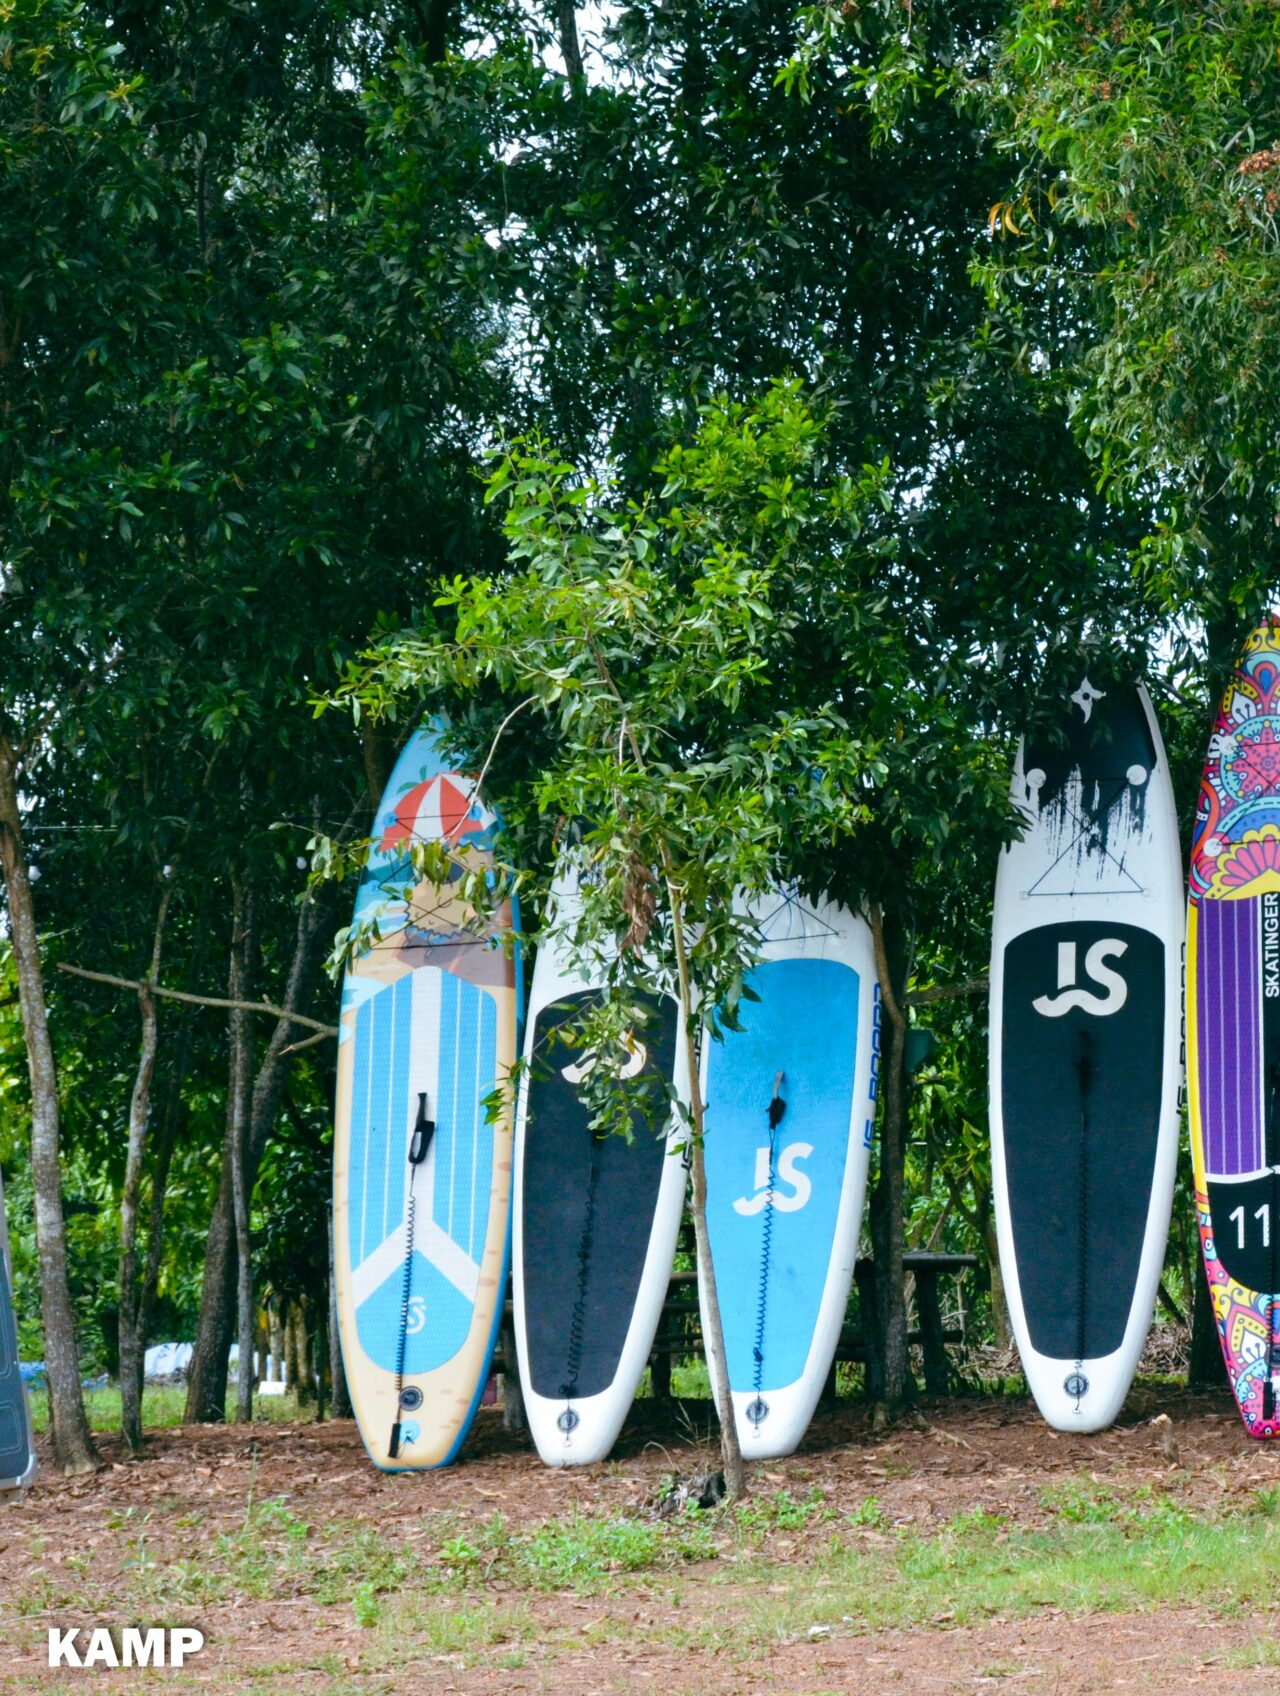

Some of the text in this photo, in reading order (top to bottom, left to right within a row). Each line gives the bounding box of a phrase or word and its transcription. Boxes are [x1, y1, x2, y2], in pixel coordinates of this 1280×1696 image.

[1032, 938, 1128, 1017] JS
[1264, 892, 1280, 998] SKATINGER
[732, 1142, 814, 1216] JS
